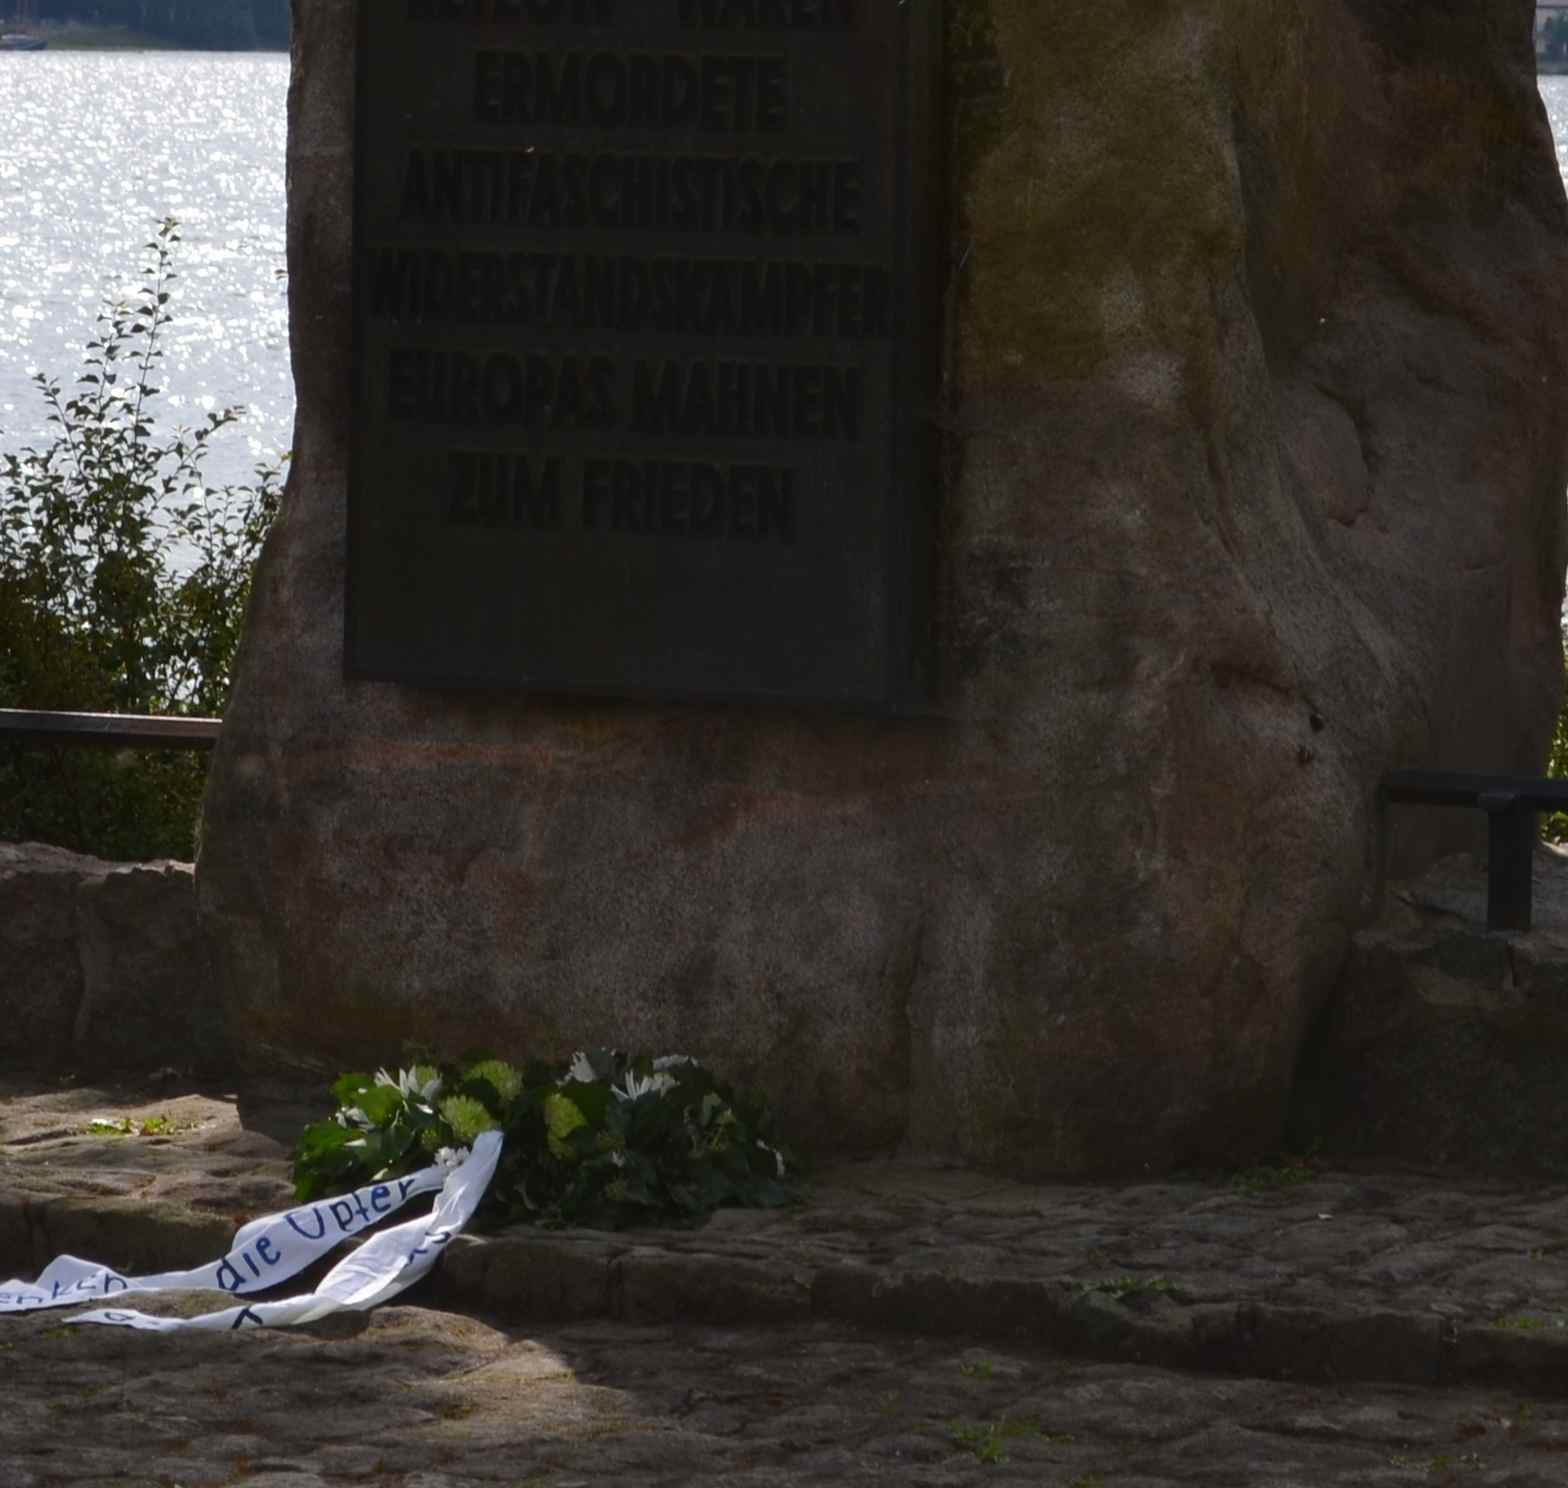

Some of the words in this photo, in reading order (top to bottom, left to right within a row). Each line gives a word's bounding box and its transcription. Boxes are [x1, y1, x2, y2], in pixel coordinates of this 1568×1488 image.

[474, 49, 788, 132] ERMORDETE
[401, 149, 863, 236] ANTIFASCHISTISCHE
[389, 348, 619, 430] EUROPAS
[633, 358, 860, 440] MAHNEN
[444, 450, 565, 530] ZUM
[580, 458, 796, 543] FRIEDEN
